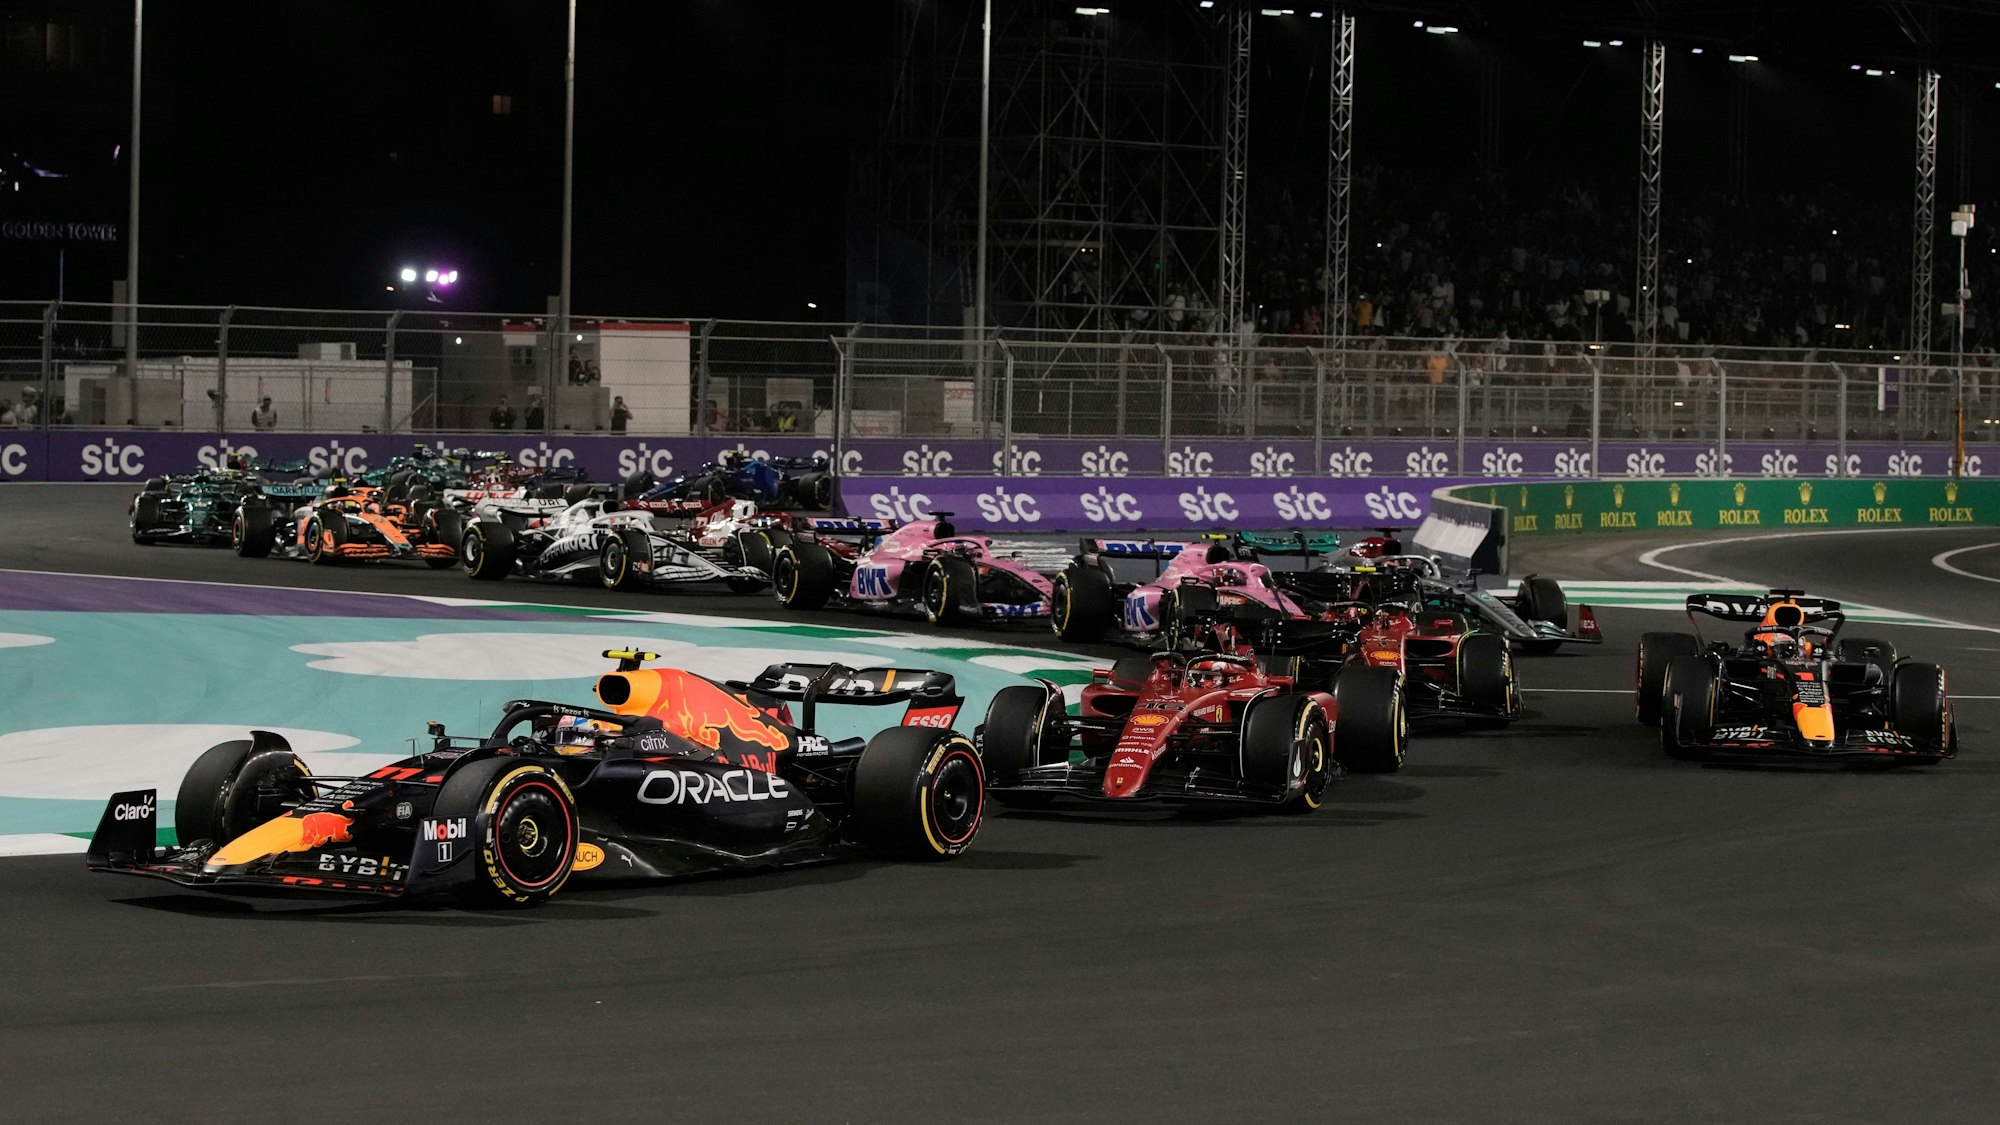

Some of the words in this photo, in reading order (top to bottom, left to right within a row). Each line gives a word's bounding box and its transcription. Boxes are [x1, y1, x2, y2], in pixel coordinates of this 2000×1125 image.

[2, 221, 64, 239] GOLDEN
[67, 222, 117, 241] TOWER
[81, 438, 145, 475] stc
[309, 440, 368, 475] stc
[619, 443, 673, 477] stc
[902, 445, 953, 477] stc
[1081, 445, 1129, 477] stc
[1168, 446, 1213, 477] stc
[1250, 446, 1295, 477] stc
[1329, 446, 1373, 477] stc
[1406, 446, 1449, 477] stc
[1482, 447, 1523, 477] stc
[1626, 448, 1665, 478] stc
[1761, 449, 1798, 478] stc
[1888, 449, 1922, 477] stc
[870, 486, 937, 522] stc
[976, 486, 1041, 522] stc
[1080, 486, 1143, 522] stc
[1179, 486, 1239, 521] stc
[1273, 485, 1332, 520] stc
[1364, 485, 1421, 519] stc
[1784, 509, 1829, 523] ROLEX
[1857, 508, 1902, 522] ROLEX
[1929, 508, 1973, 521] ROLEX
[1555, 514, 1582, 529] ROLEX
[1600, 512, 1636, 526] ROLEX
[1657, 511, 1692, 526] ROLEX
[1719, 510, 1760, 524] ROLEX
[857, 567, 892, 596] BWT
[561, 706, 582, 716] Tezos
[908, 714, 952, 731] ESSO
[640, 736, 669, 751] citrix
[797, 736, 829, 753] HRC
[1712, 724, 1768, 740] BYBIT
[1114, 747, 1150, 755] MAHLE
[369, 766, 424, 781] 11
[637, 769, 790, 805] ORACLE
[114, 802, 151, 821] Claro
[423, 818, 466, 841] Mobil
[319, 854, 410, 880] BYBIT
[575, 850, 598, 863] AUCH
